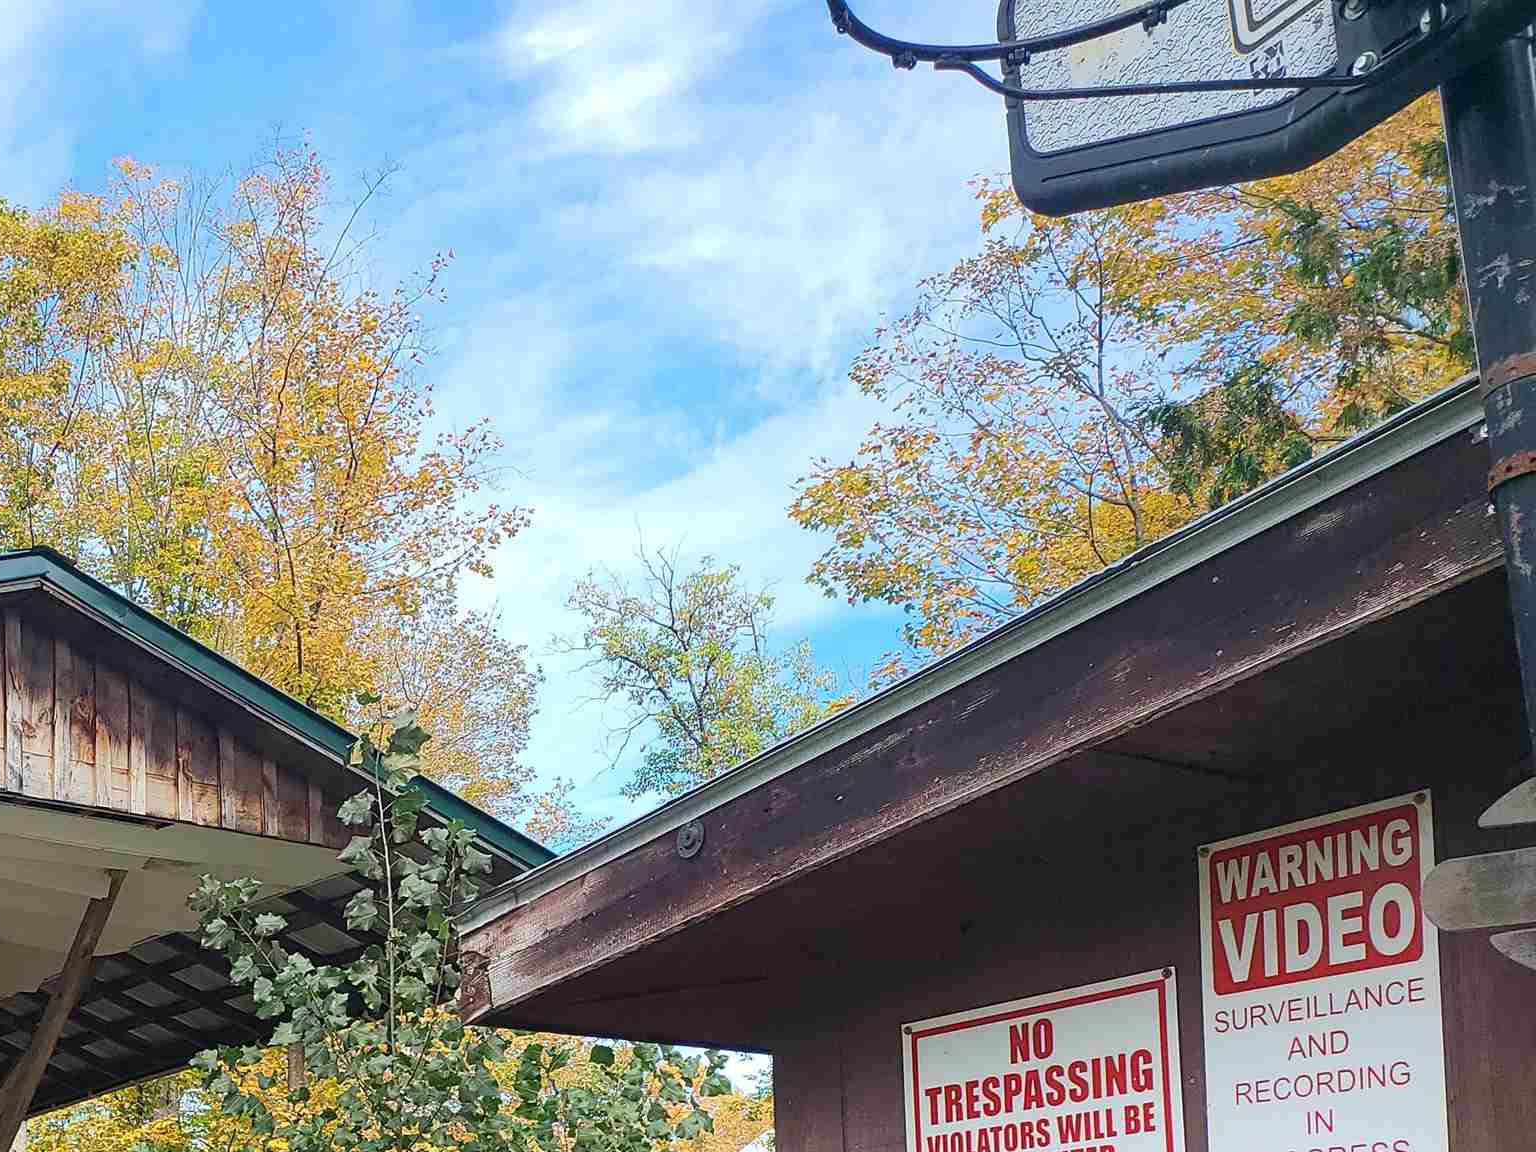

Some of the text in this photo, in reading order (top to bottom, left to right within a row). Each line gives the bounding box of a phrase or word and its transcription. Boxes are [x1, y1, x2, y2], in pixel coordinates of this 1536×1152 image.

[1216, 818, 1412, 904] WARNING
[1218, 882, 1415, 983] VIDEO
[1214, 977, 1425, 1033] SURVEILLANCE
[1009, 1018, 1054, 1064] NO
[1288, 1030, 1349, 1060] AND
[924, 1049, 1154, 1125] TRESPASSING
[1235, 1061, 1411, 1105] RECORDING
[1057, 1108, 1117, 1144] WILL
[1124, 1102, 1156, 1135] BE
[1306, 1109, 1334, 1135] IN
